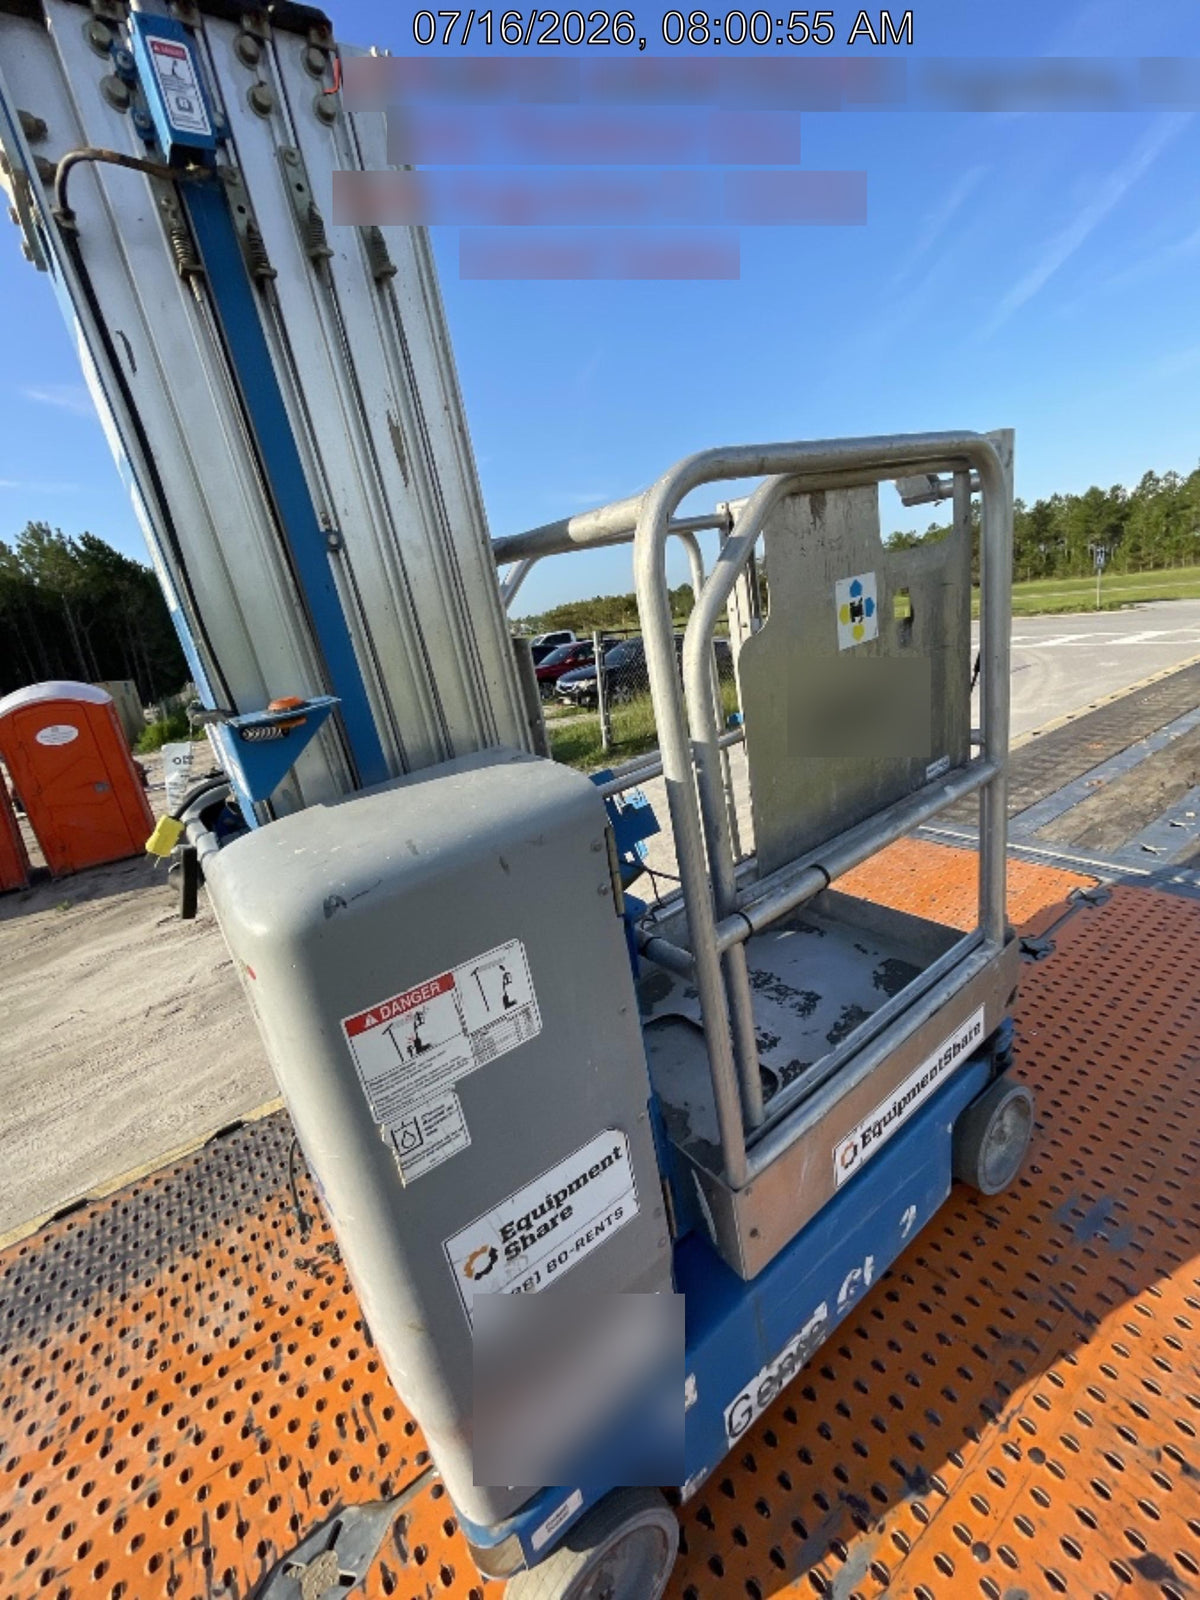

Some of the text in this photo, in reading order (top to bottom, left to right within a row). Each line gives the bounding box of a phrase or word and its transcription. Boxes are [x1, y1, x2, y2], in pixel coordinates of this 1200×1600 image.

[380, 981, 442, 1020] DANGER
[860, 1022, 981, 1150] EquipmentShare
[498, 1144, 623, 1245] Equipment
[504, 1204, 574, 1262] Share
[546, 1206, 623, 1273] 80-RENTS
